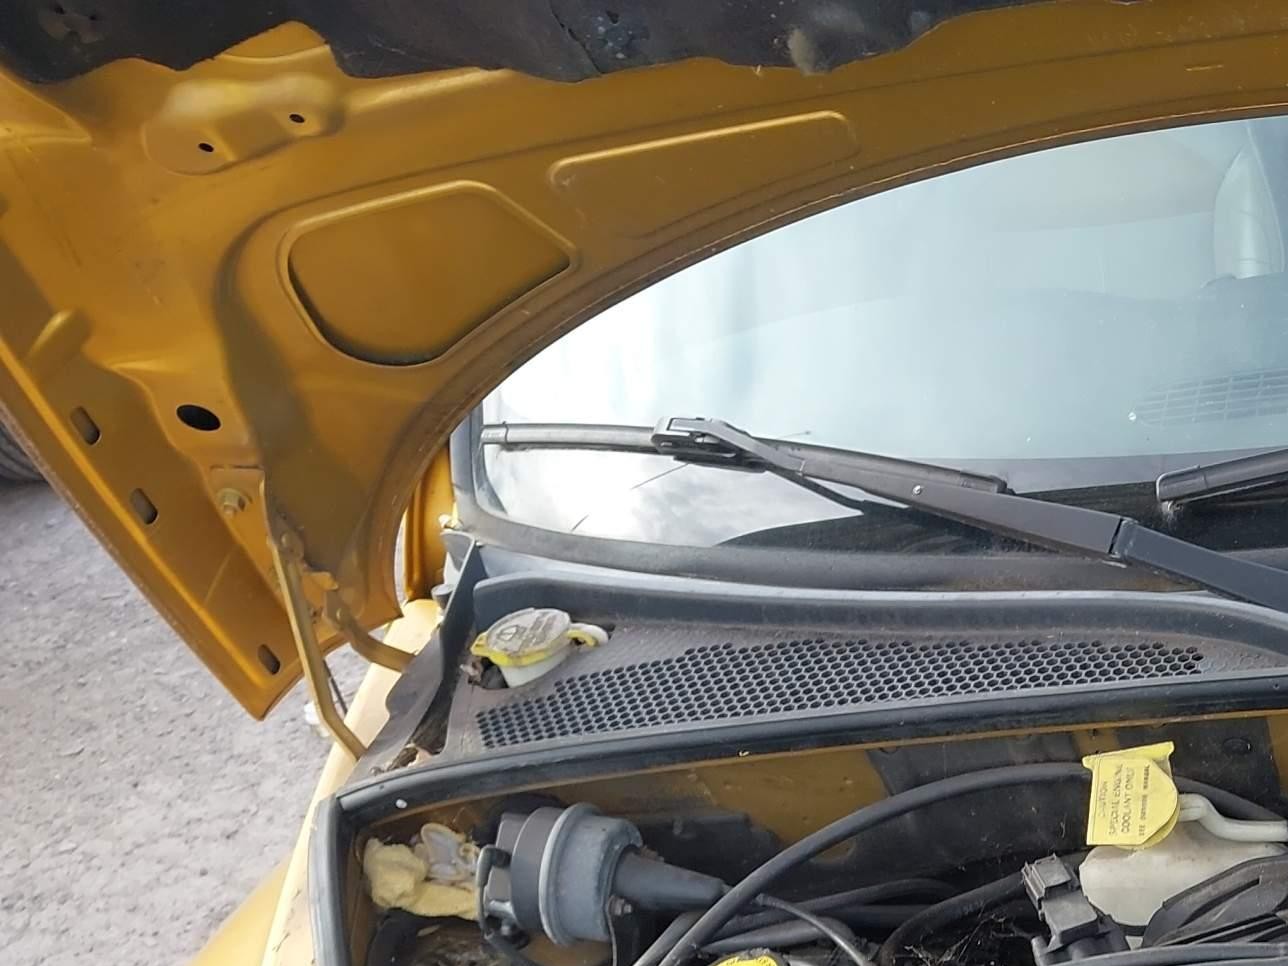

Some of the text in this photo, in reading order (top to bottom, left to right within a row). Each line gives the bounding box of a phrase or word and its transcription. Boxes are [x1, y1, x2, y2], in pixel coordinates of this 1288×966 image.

[1109, 764, 1124, 836] SPECIAL ENGINE
[1121, 766, 1136, 834] COOLANT ONLY
